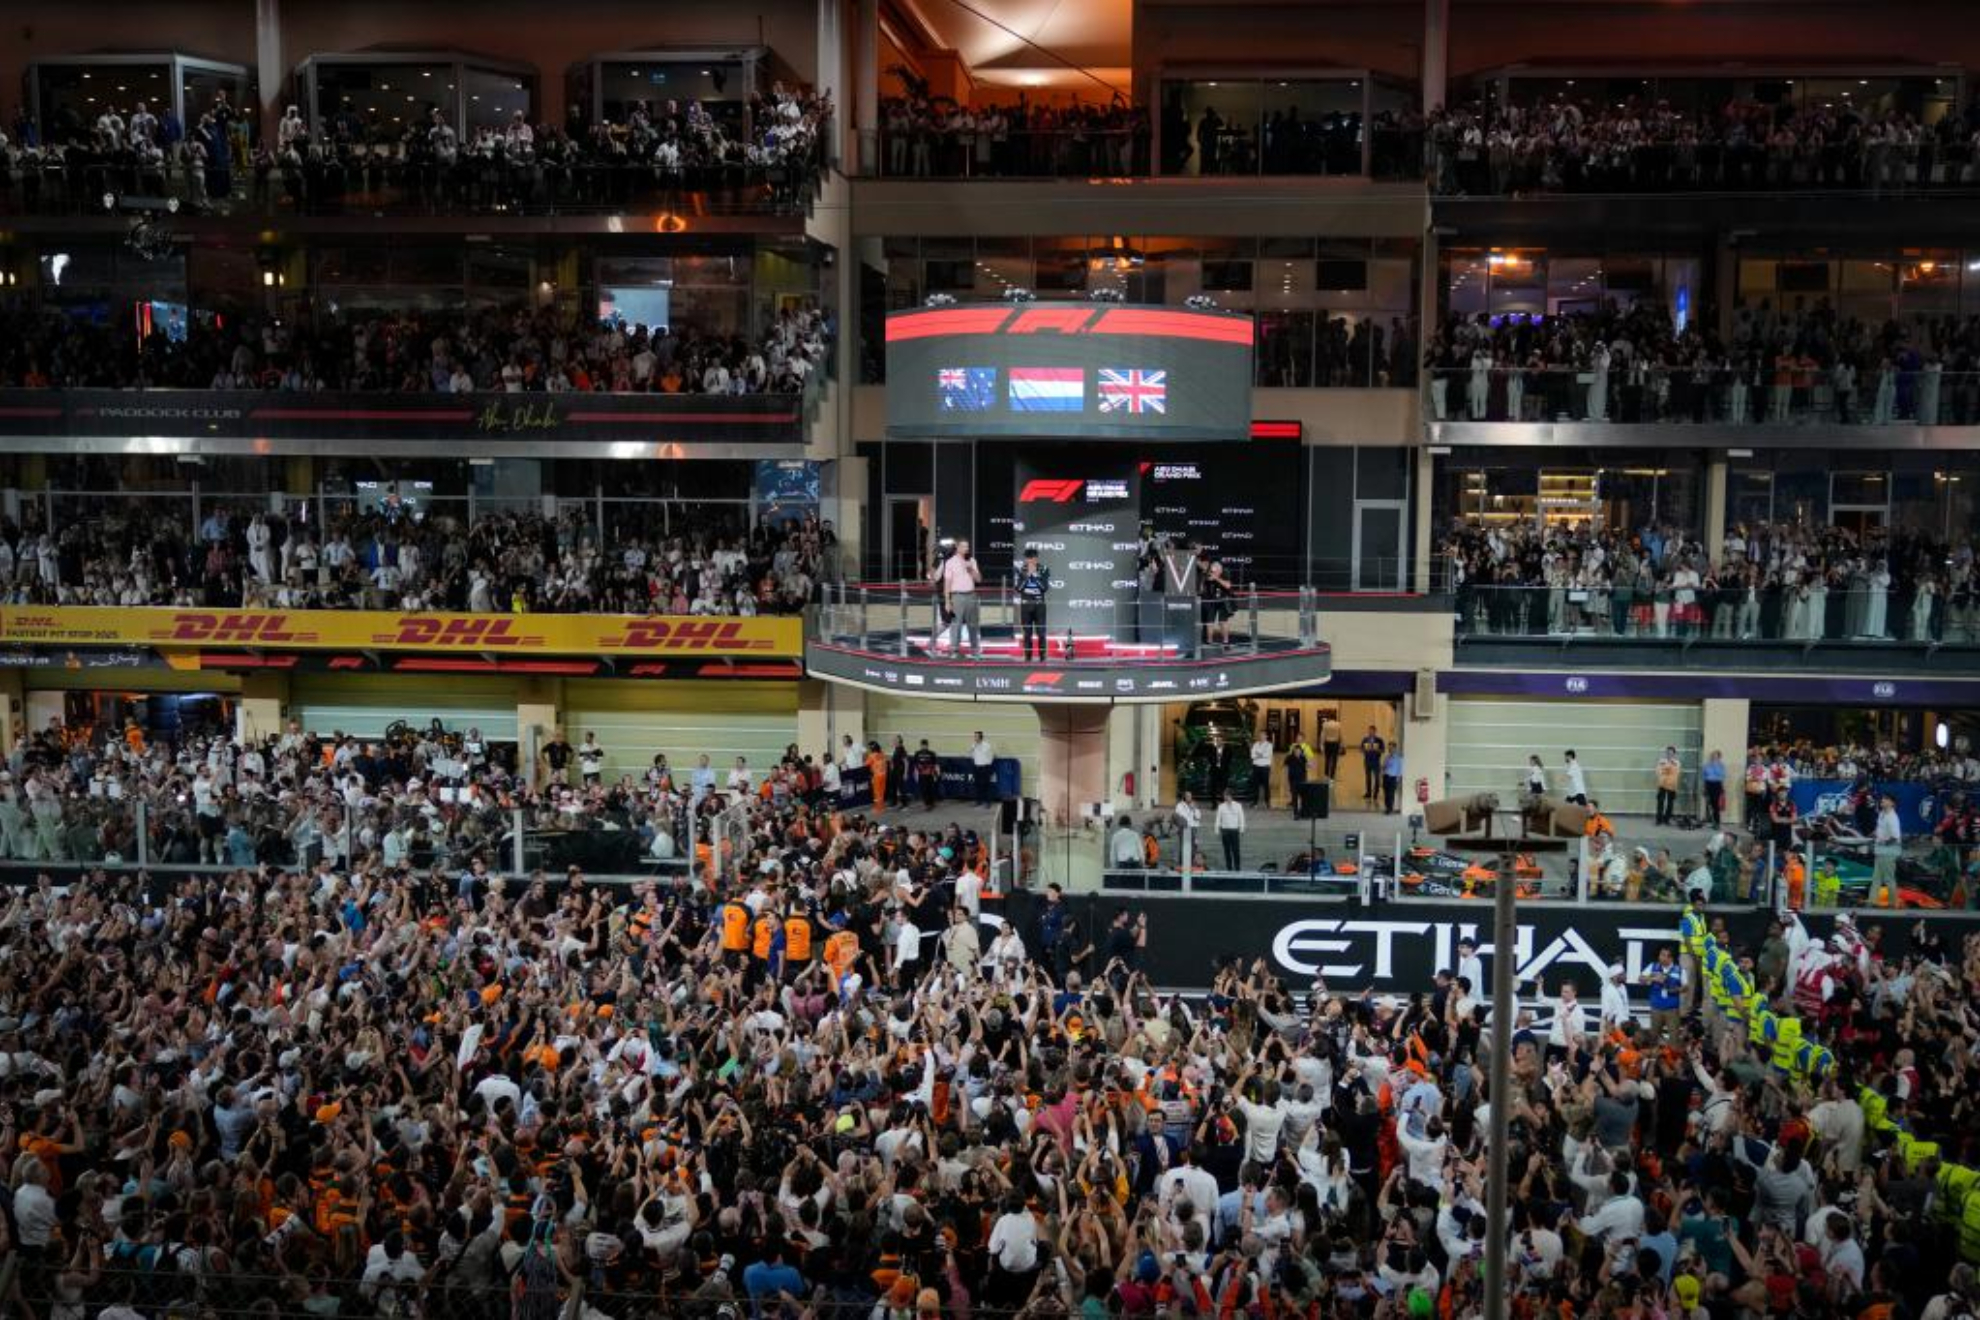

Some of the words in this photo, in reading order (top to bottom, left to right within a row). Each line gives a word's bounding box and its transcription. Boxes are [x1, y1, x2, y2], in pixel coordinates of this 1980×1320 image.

[101, 408, 191, 418] PADDOCK
[193, 409, 241, 419] CLUB
[1020, 479, 1084, 502] F1
[1069, 523, 1115, 532] ETIHAD
[1069, 561, 1115, 570] ETIHAD
[1069, 599, 1115, 608] ETIHAD
[174, 615, 293, 641] DHL
[397, 618, 520, 646] DHL
[624, 621, 748, 649] DHL
[976, 677, 1010, 688] LVMH
[1567, 680, 1587, 690] FIA
